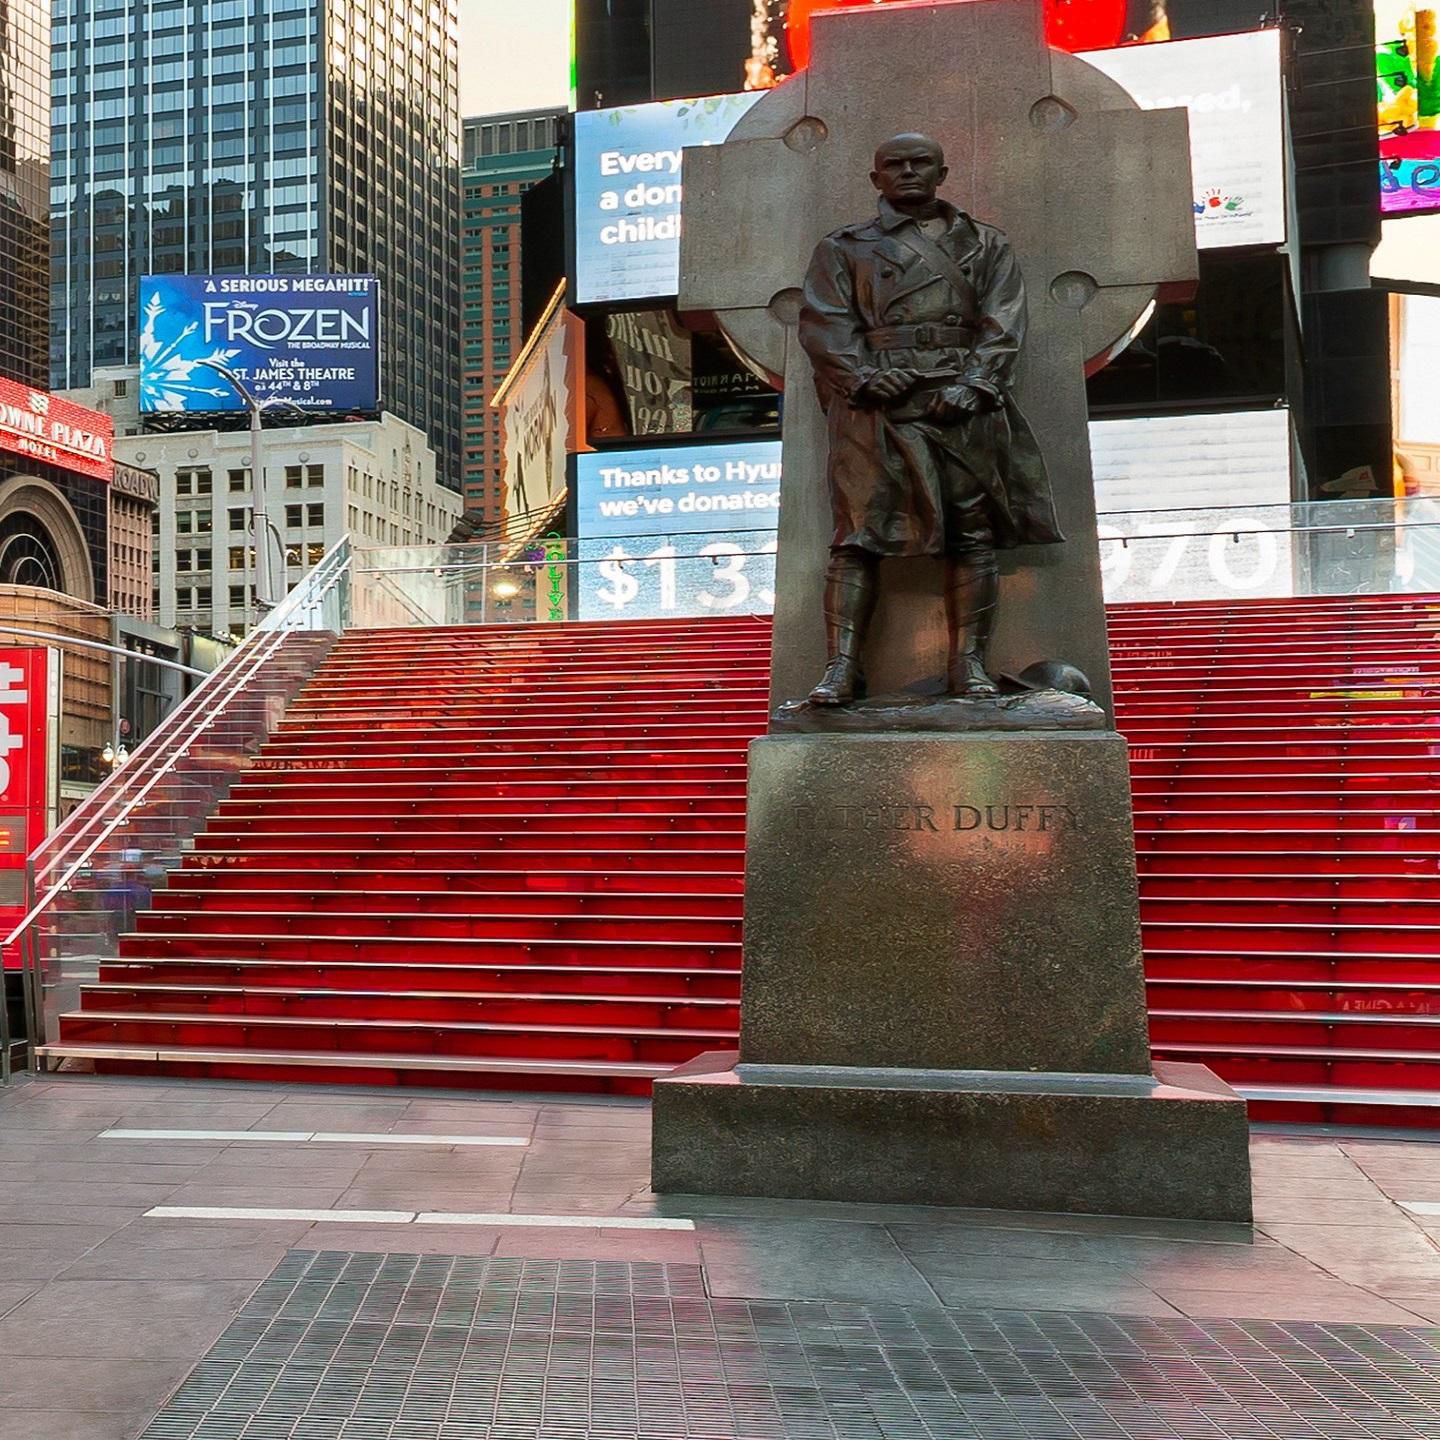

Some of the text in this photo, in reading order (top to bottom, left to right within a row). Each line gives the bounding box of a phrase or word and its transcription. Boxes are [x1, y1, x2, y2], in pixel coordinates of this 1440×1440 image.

[599, 191, 618, 210] a
[220, 278, 289, 293] SERIOUS
[203, 302, 370, 350] FROZEN
[269, 357, 305, 367] Visit the
[253, 368, 295, 380] JAMES
[299, 368, 355, 380] THEATRE
[292, 383, 301, 391] &
[18, 438, 57, 461] HOTEL
[50, 422, 106, 457] PLAZA
[600, 464, 689, 488] Thanks
[693, 463, 720, 482] to
[600, 496, 672, 517] we've
[597, 538, 777, 610] $13
[791, 804, 1084, 833] FATHER DUFFY
